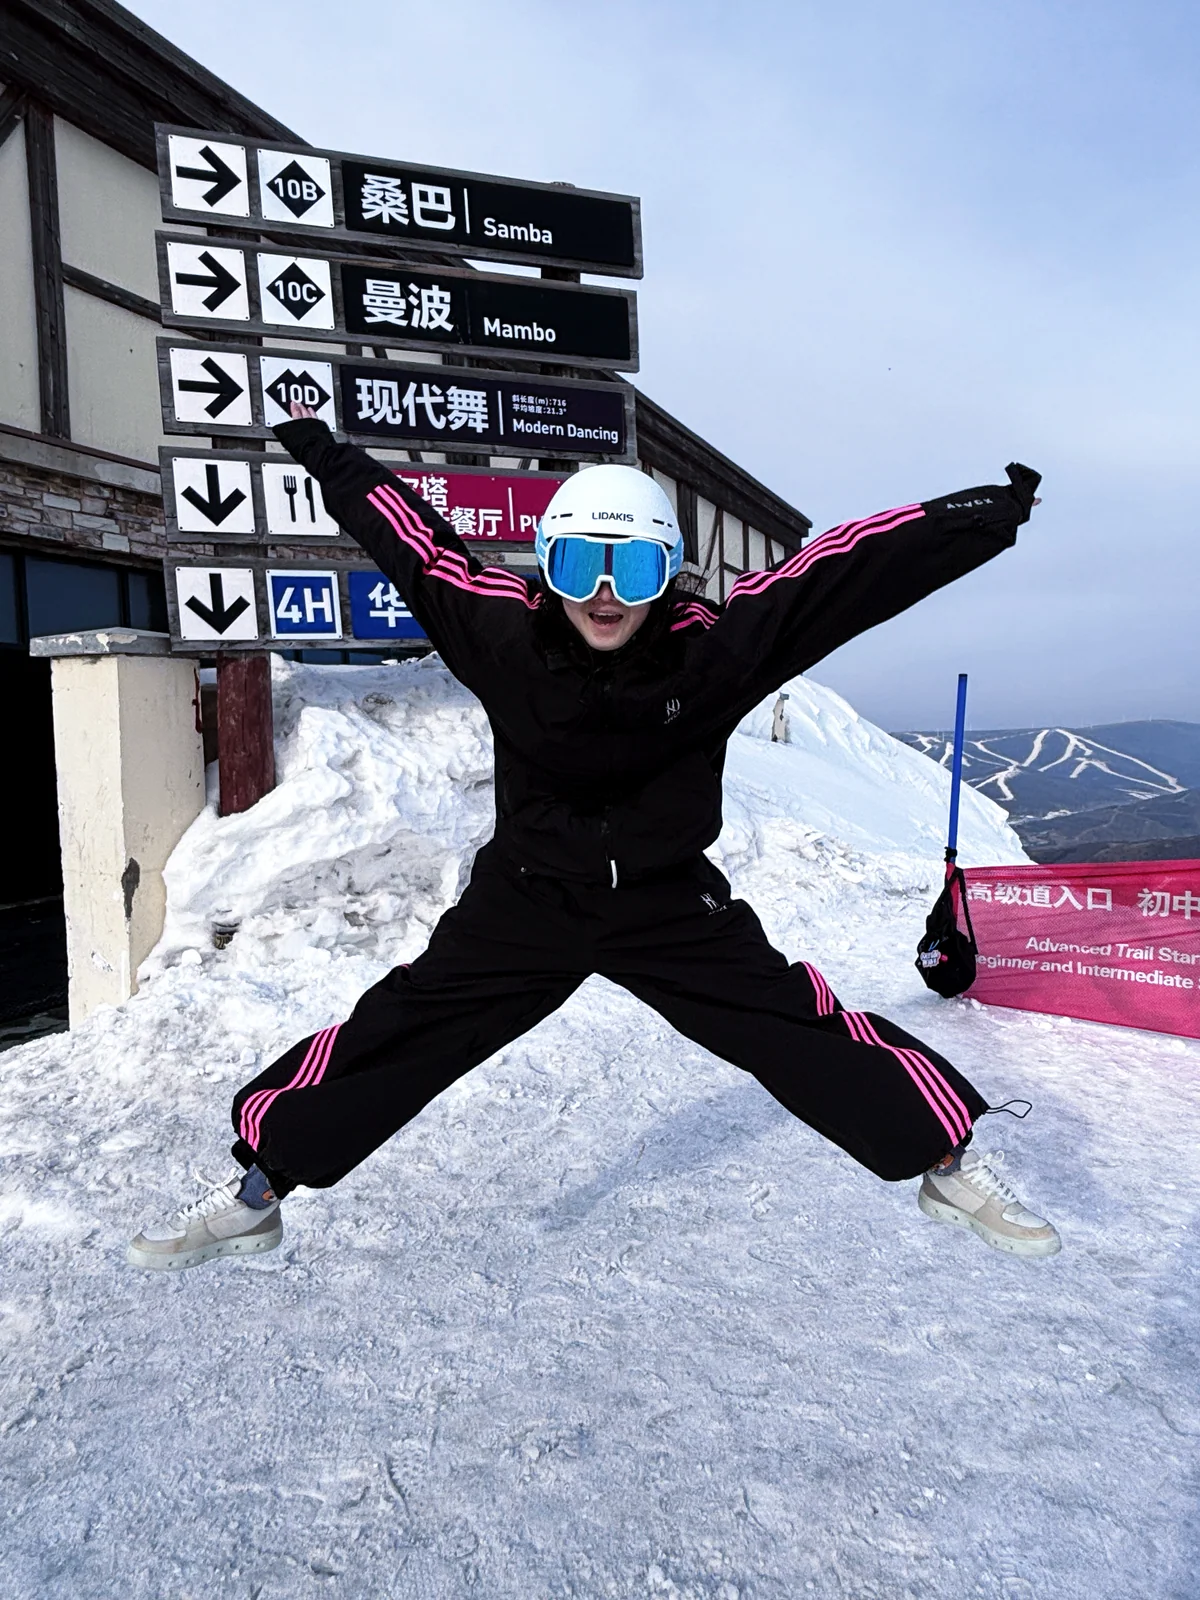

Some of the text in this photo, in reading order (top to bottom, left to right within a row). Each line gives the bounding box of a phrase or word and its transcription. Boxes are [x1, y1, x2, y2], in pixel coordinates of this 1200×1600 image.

[274, 177, 319, 203] 10B
[361, 173, 456, 231] 桑巴
[483, 217, 553, 245] Samba
[274, 280, 318, 304] 10C
[362, 279, 454, 332] 曼波
[483, 316, 557, 343] Mambo
[276, 382, 320, 406] 10D
[355, 377, 490, 434] 现代舞
[512, 418, 619, 444] Modern Dancing
[592, 511, 635, 523] LIDAKIS
[276, 587, 333, 623] 4H
[368, 581, 413, 628] 华
[966, 882, 1200, 920] 高级道入口 初中
[1025, 936, 1112, 957] Advanced
[1115, 943, 1154, 961] Trail
[1040, 961, 1073, 974] and
[1077, 961, 1194, 989] Intermediate
